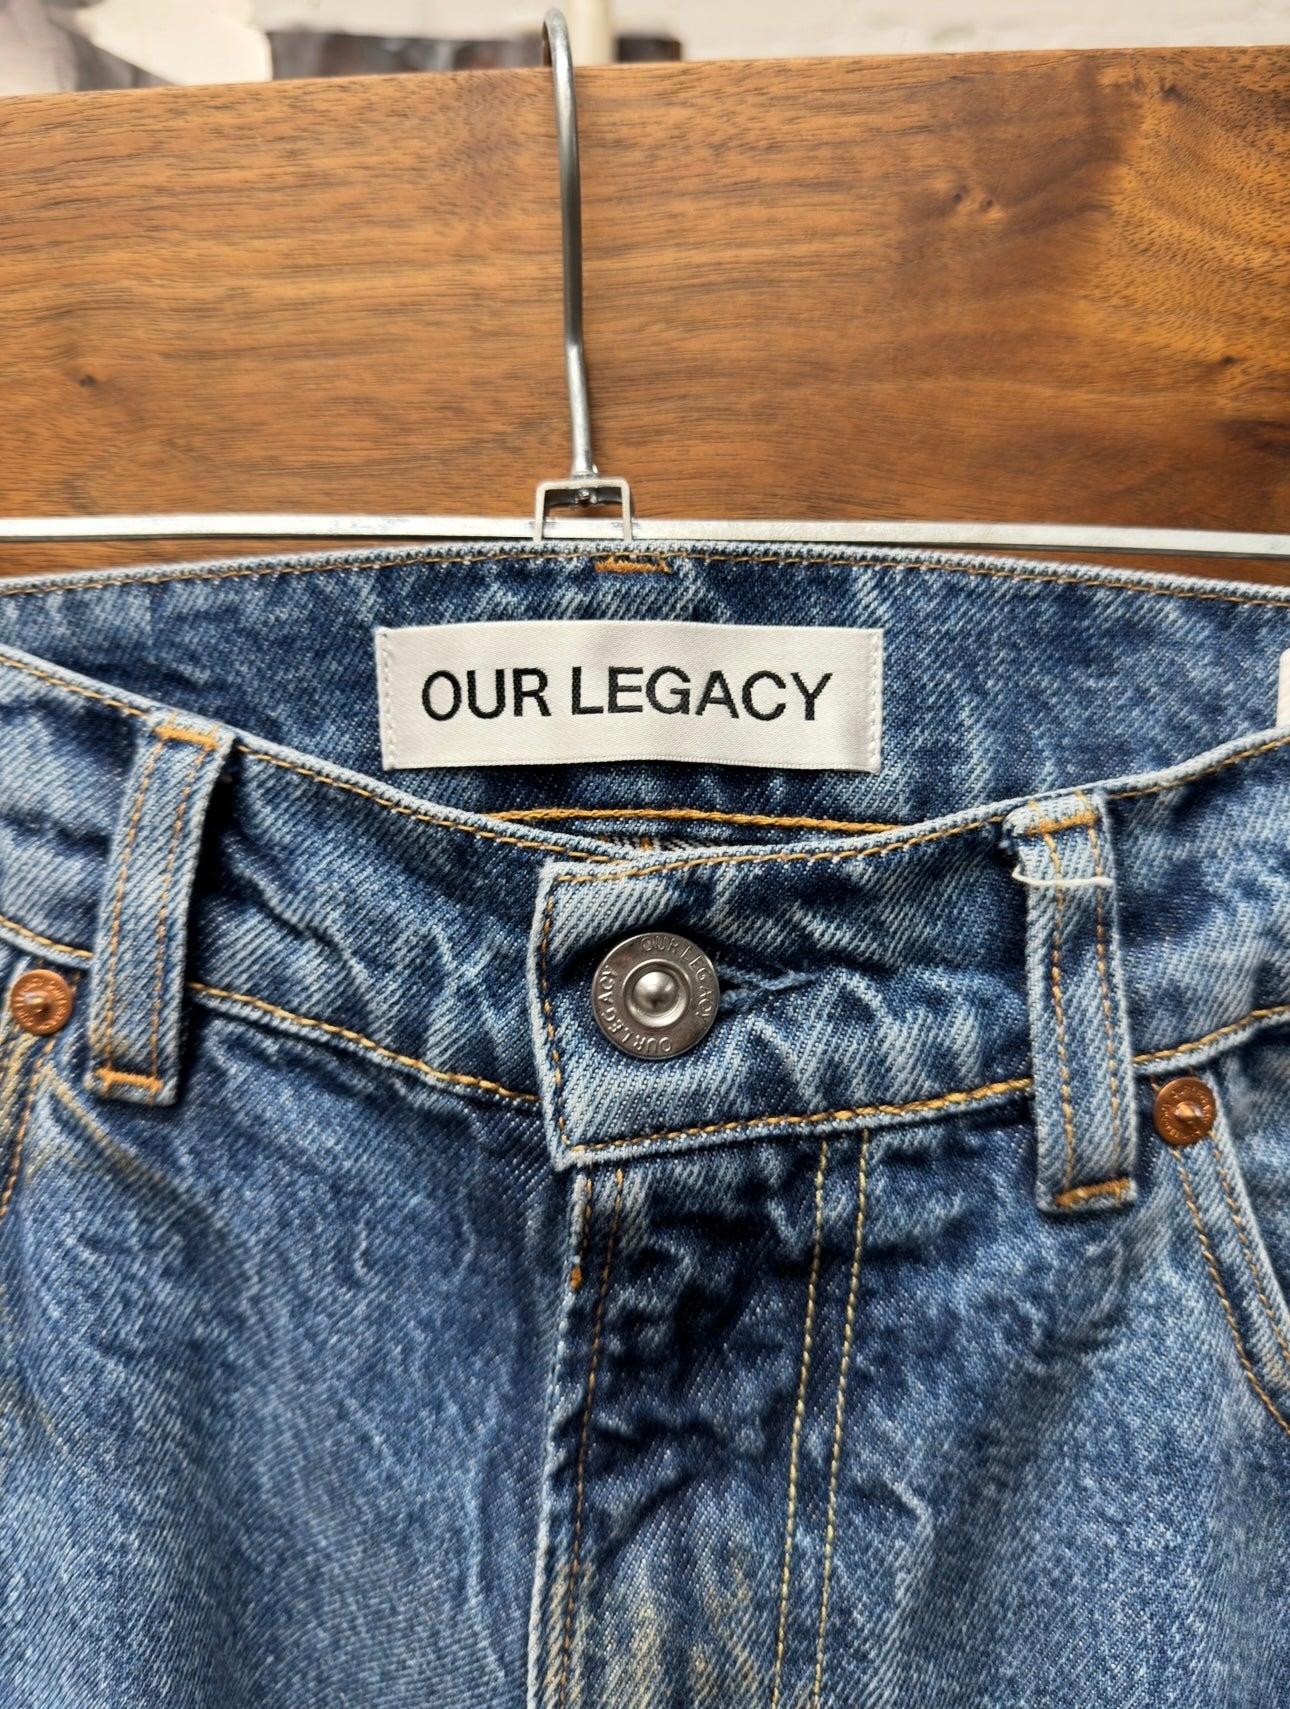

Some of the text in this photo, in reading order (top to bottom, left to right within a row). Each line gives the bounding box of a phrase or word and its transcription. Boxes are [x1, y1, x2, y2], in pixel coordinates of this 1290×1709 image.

[421, 665, 833, 722] OUR LEGACY
[598, 965, 673, 1052] OUR LEGACY
[640, 935, 714, 1023] OUR LEGACY
